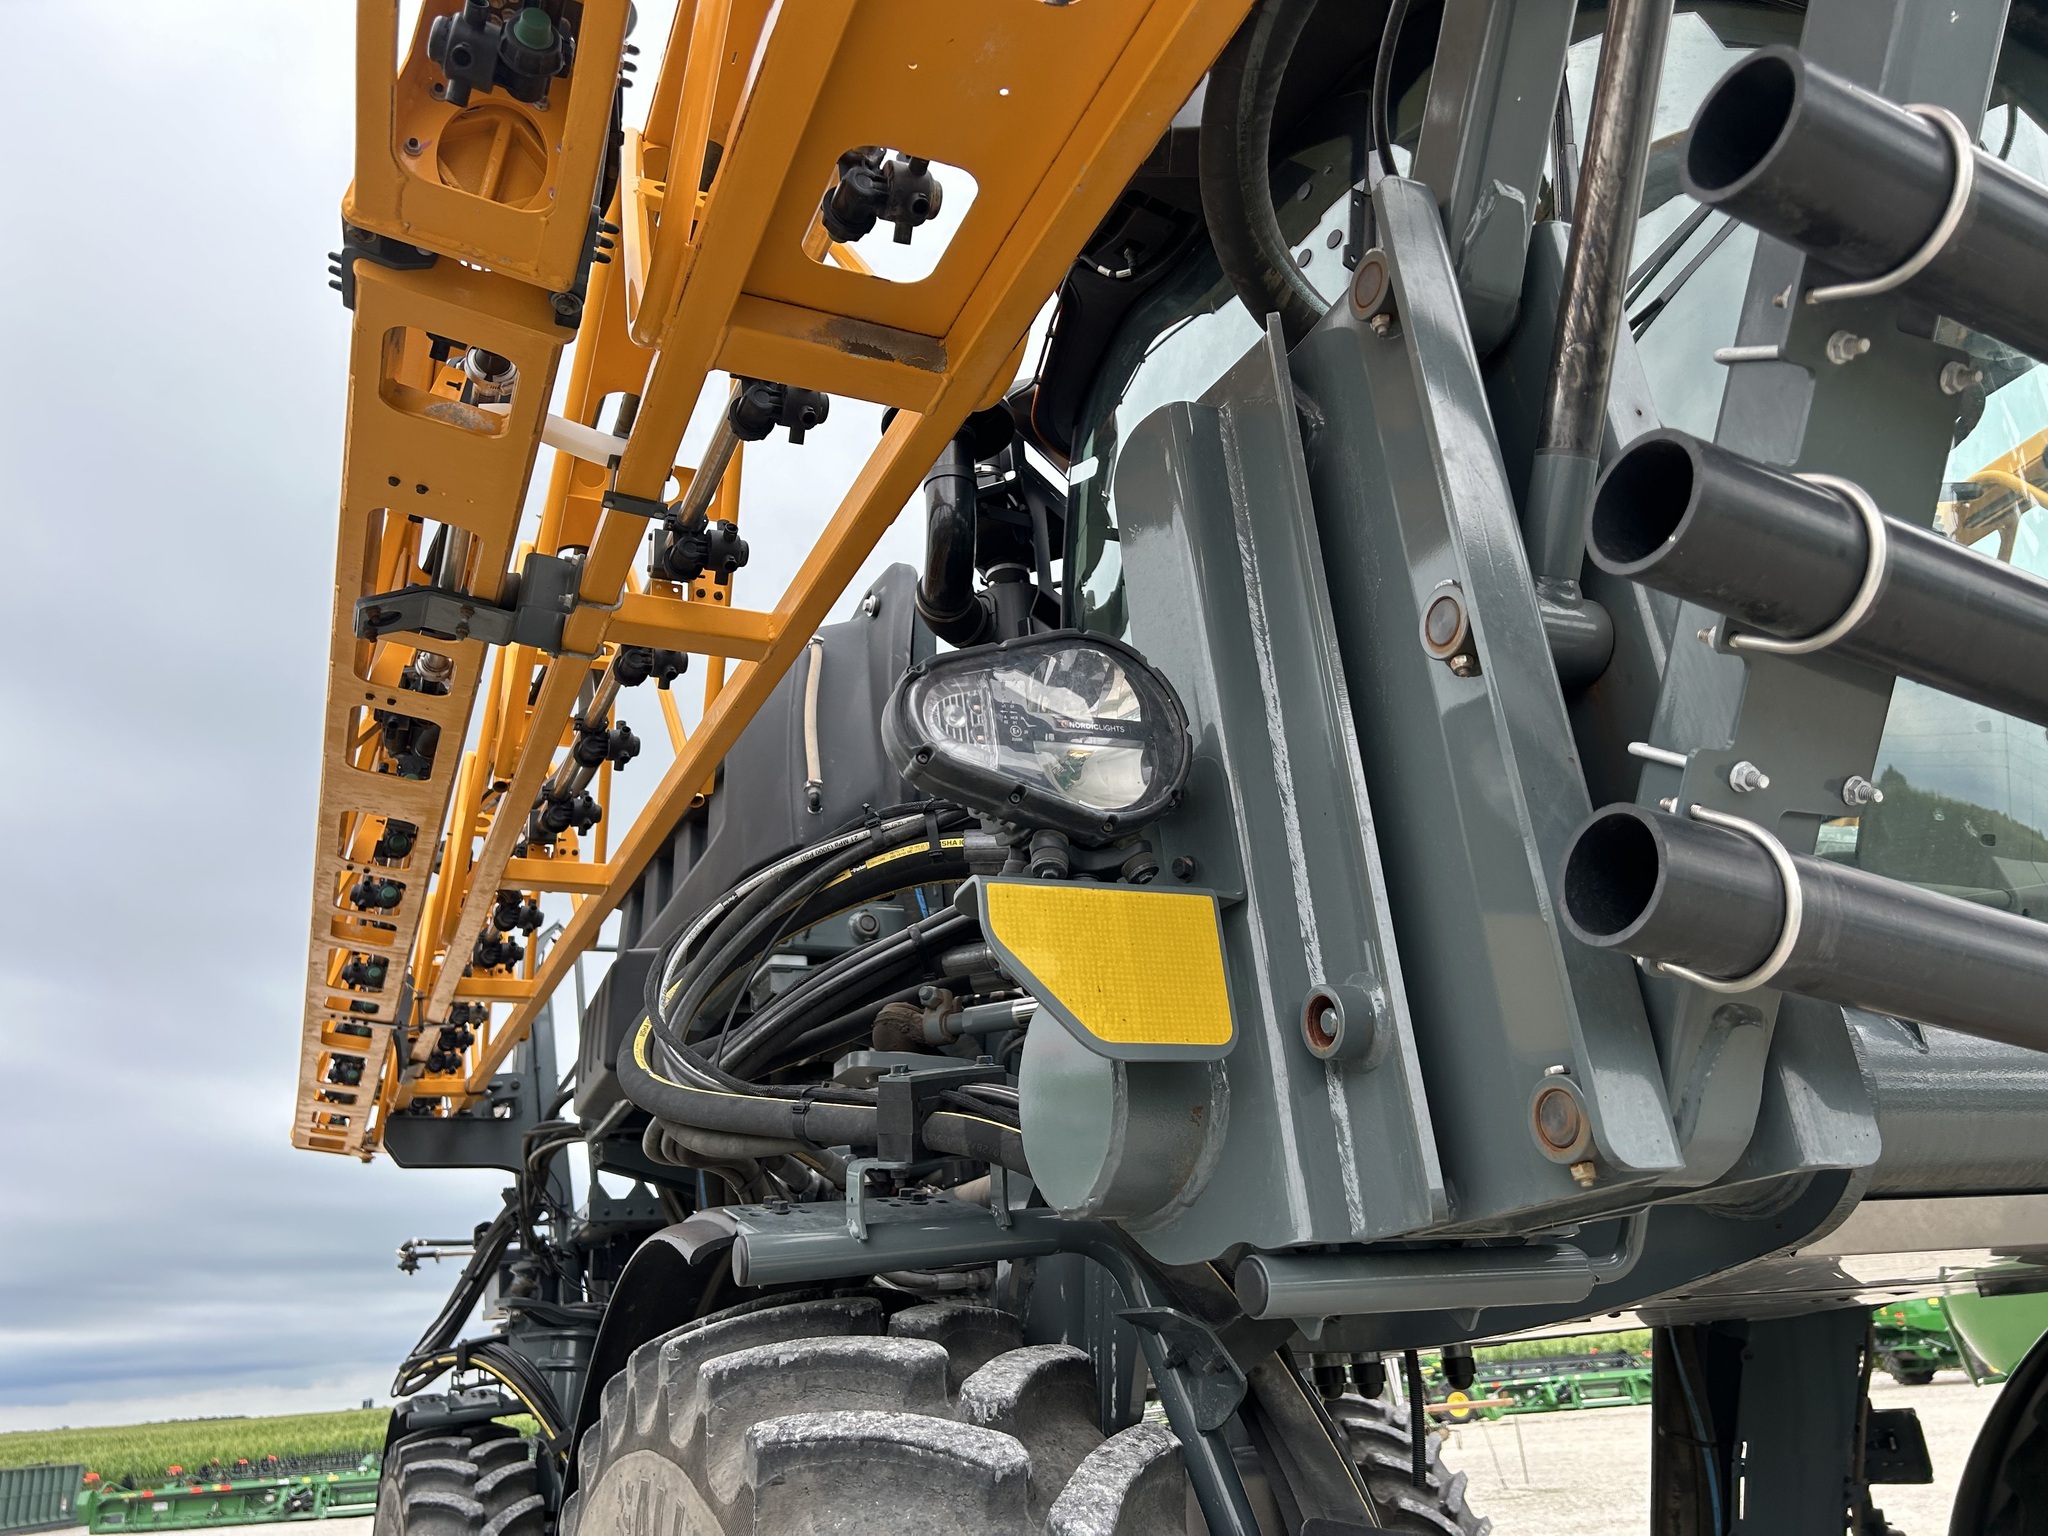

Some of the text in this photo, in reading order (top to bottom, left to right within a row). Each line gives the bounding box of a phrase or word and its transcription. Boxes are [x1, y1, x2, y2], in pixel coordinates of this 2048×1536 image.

[1069, 721, 1125, 733] NORDICLIGHTS
[834, 838, 849, 849] MPa
[941, 839, 958, 847] SHA
